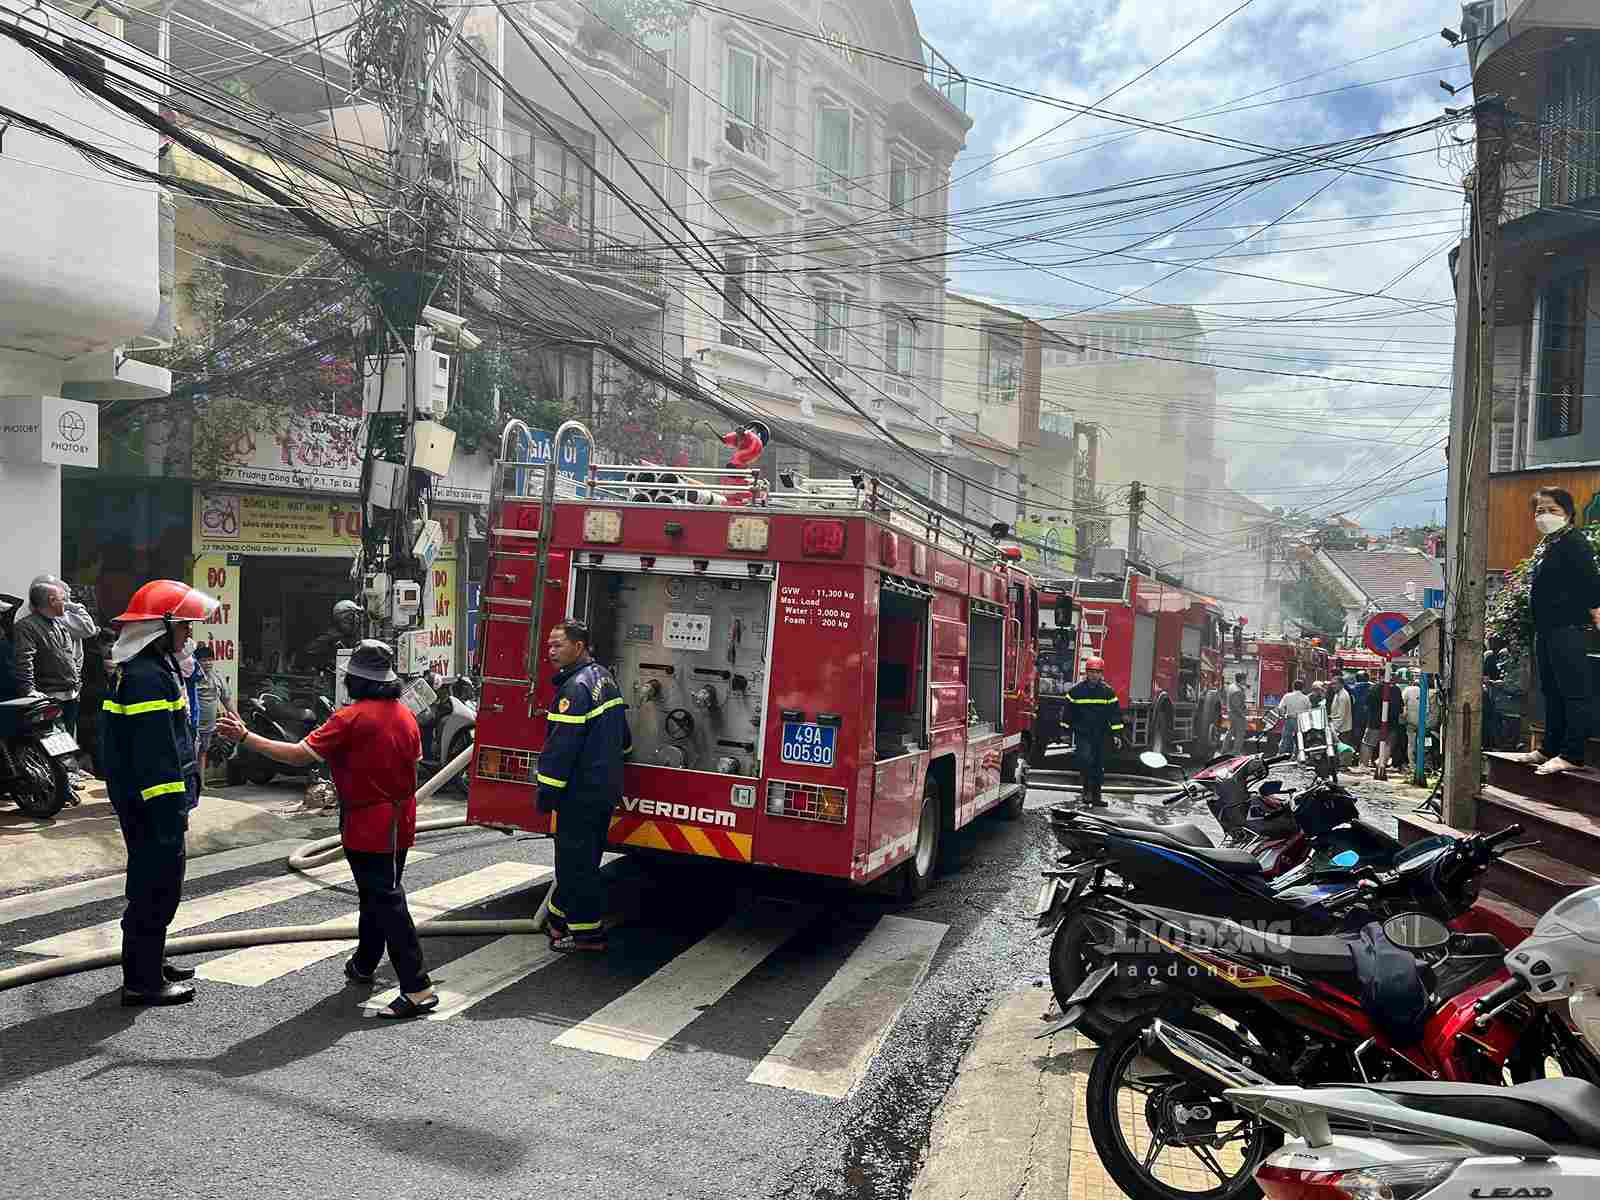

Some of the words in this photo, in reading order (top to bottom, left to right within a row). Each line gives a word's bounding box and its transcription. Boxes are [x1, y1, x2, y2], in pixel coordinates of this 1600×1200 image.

[50, 442, 89, 453] PHOTOBY
[781, 586, 801, 595] GVW
[801, 598, 820, 606] Load
[784, 616, 806, 625] Foam
[795, 726, 822, 745] 49A
[783, 742, 832, 764] 005.90
[614, 796, 737, 827] VERDIGM
[1469, 1186, 1554, 1199] LEAD
